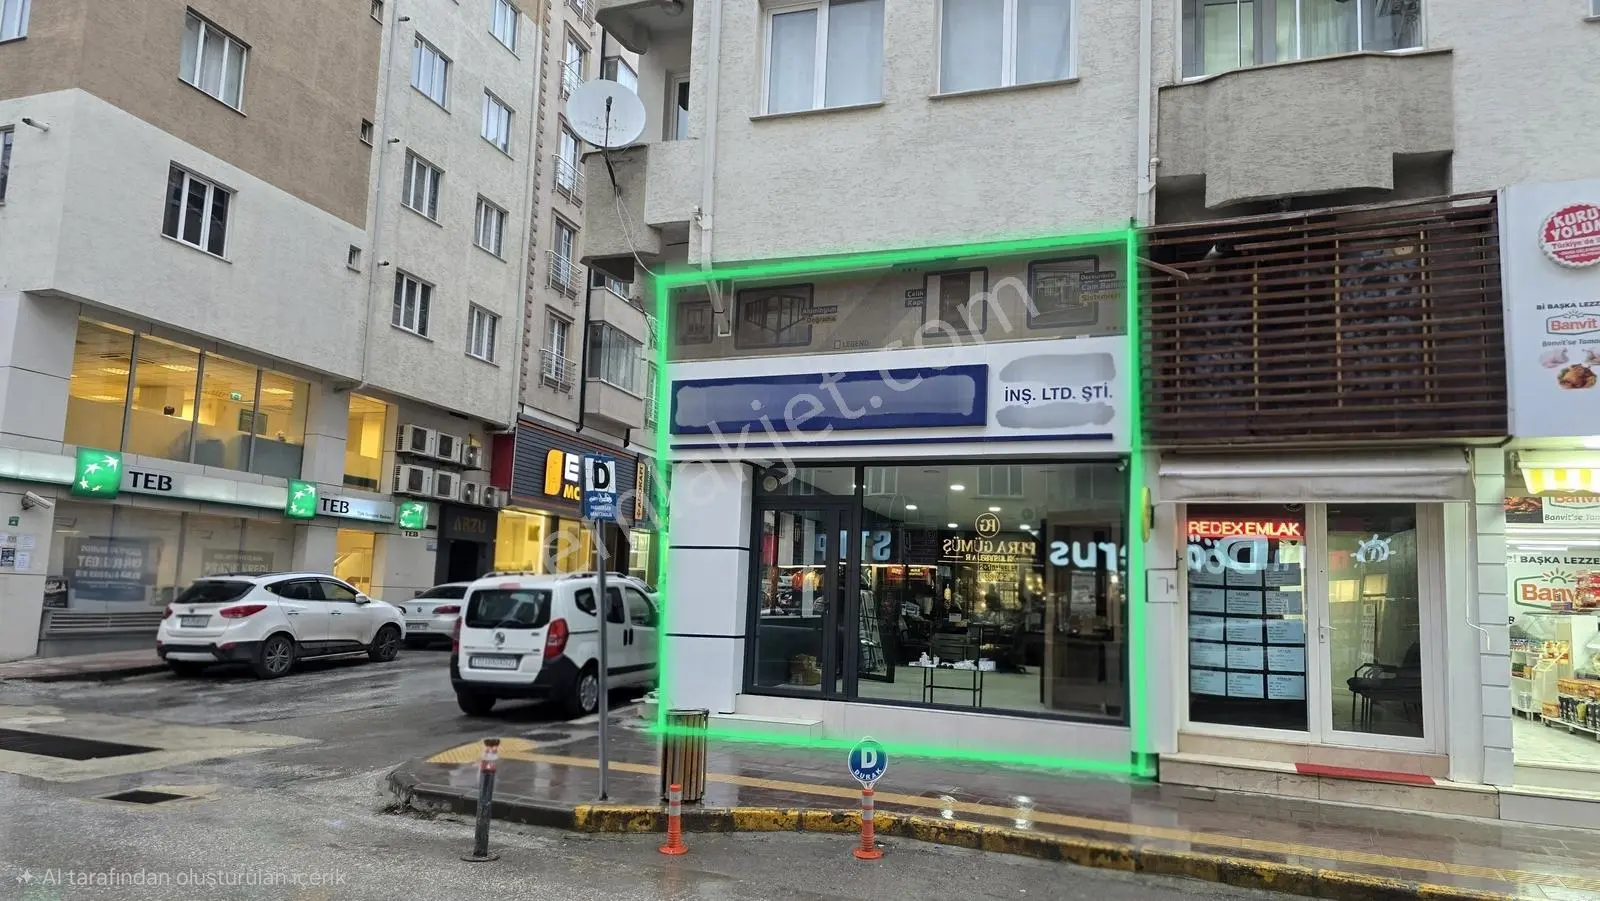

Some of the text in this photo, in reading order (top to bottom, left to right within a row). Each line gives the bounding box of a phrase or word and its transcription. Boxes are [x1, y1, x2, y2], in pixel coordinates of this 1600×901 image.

[1553, 208, 1599, 228] KURU
[1547, 302, 1576, 310] BAŞKA
[1551, 318, 1598, 330] Banvit
[1005, 382, 1112, 404] İNŞ. LTD. ŞTİ.
[129, 471, 172, 491] TEB
[593, 462, 610, 489] D
[320, 497, 349, 514] TEB
[453, 515, 487, 534] ARZU
[1188, 521, 1300, 536] REDEX EMLAK
[404, 530, 419, 538] TEB
[1520, 556, 1560, 565] BAŞKA
[861, 747, 877, 768] D
[854, 768, 882, 779] DURAK
